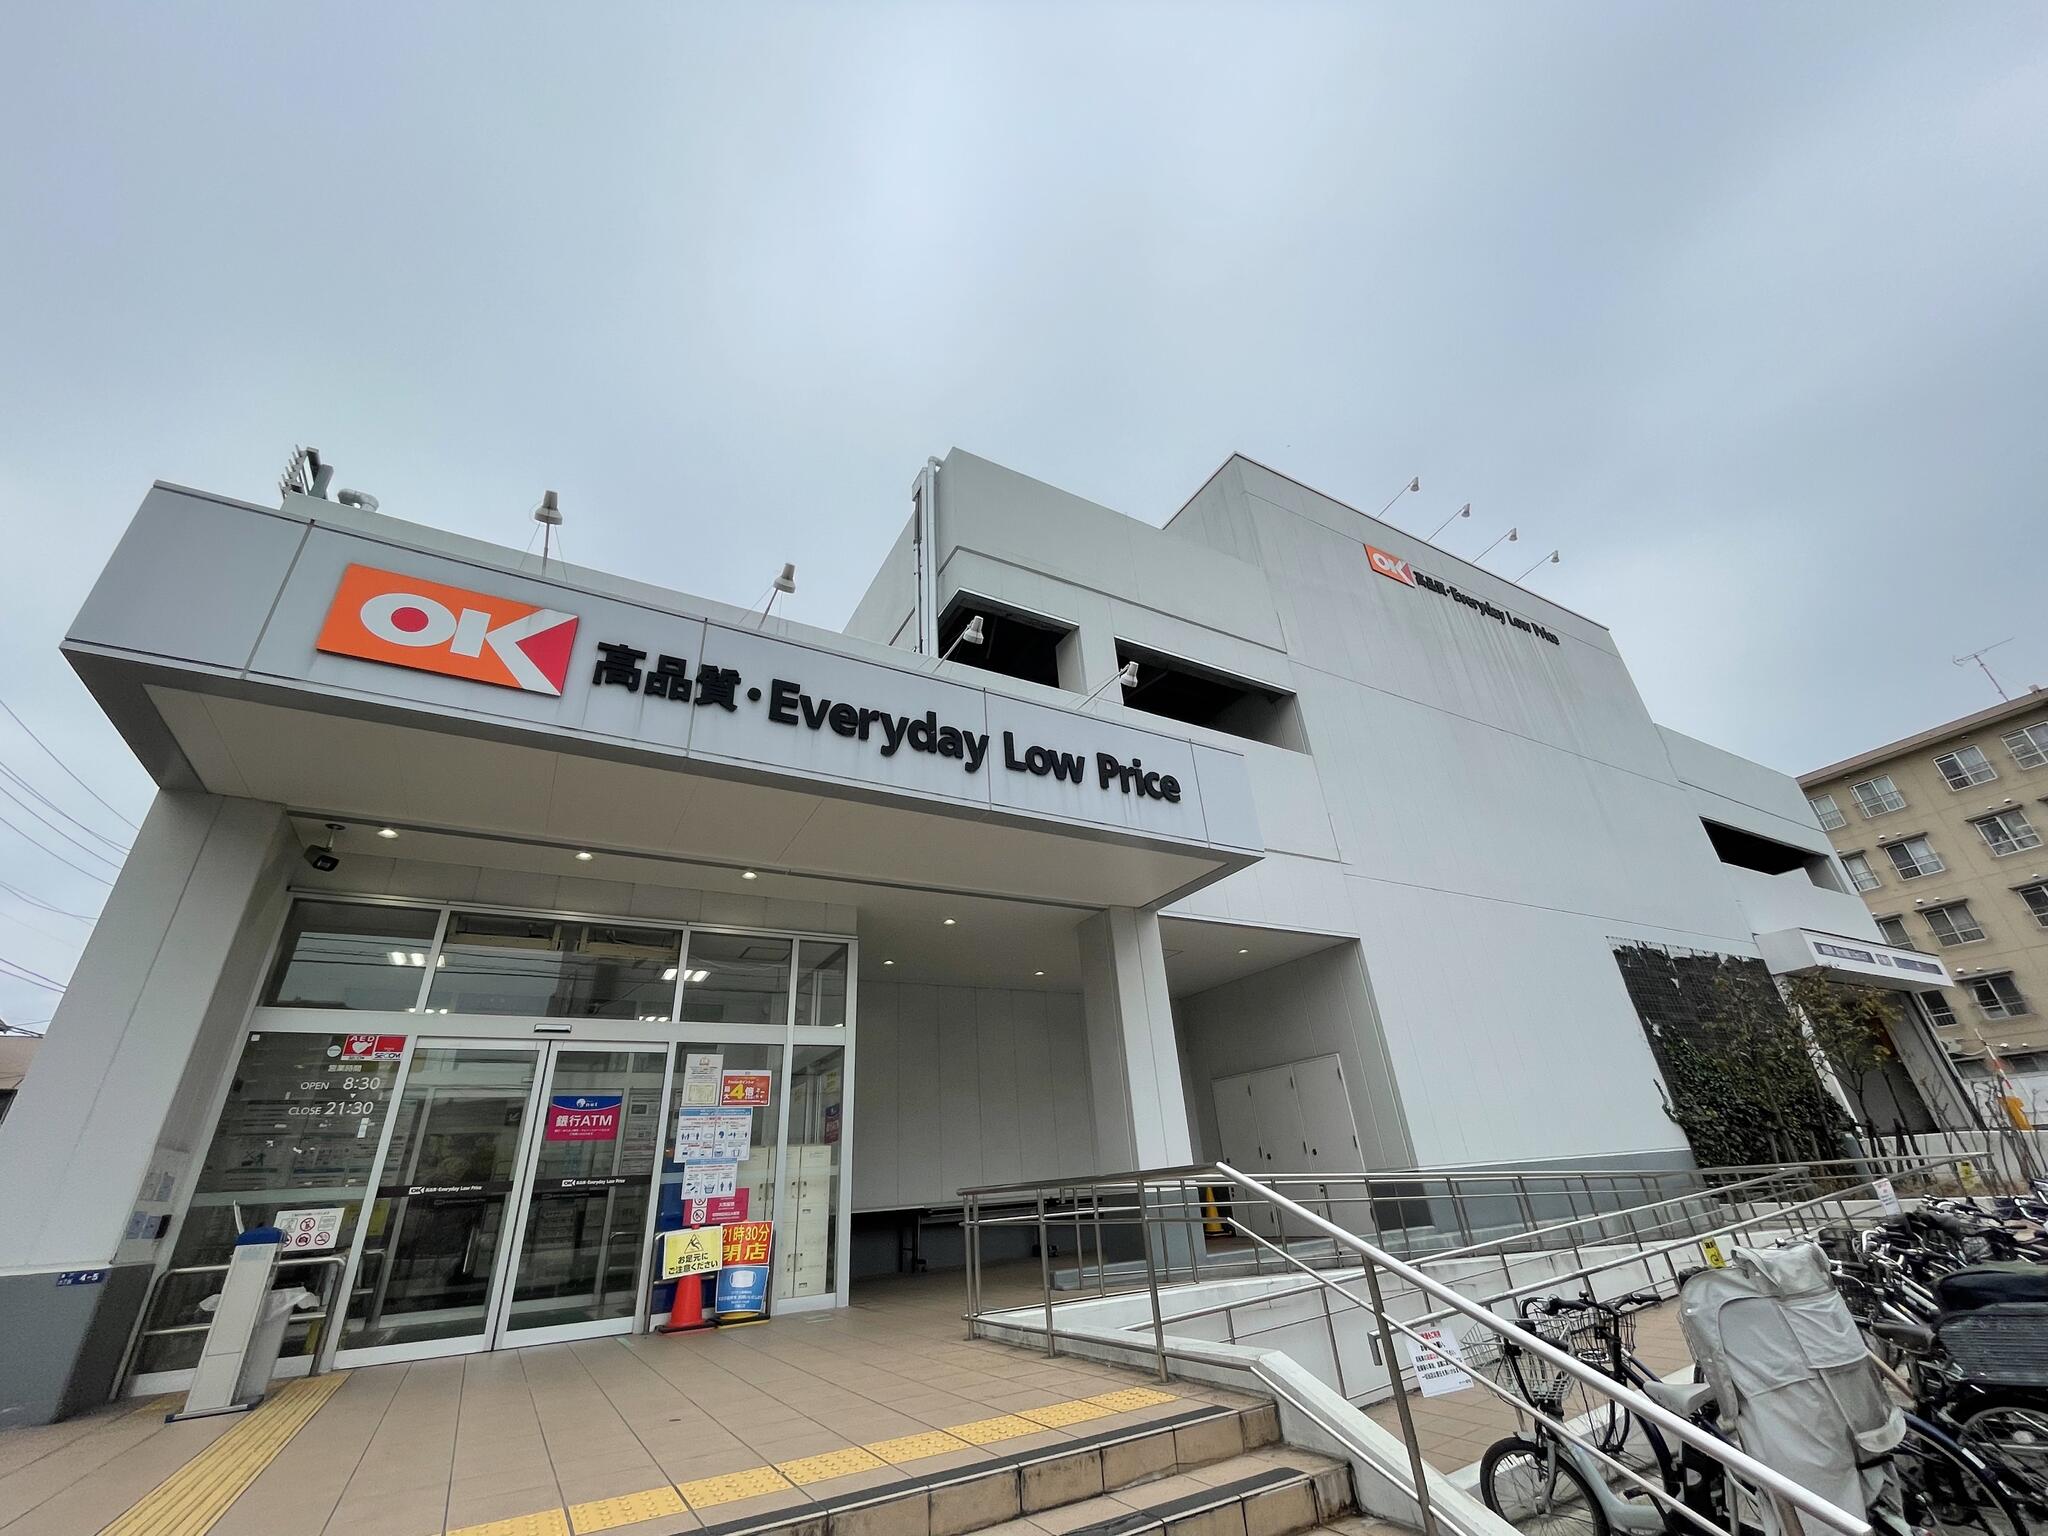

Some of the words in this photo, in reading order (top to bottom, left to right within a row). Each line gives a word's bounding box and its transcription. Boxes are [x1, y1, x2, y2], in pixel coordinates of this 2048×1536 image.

[1373, 553, 1415, 587] OK
[360, 593, 578, 697] OK
[767, 678, 990, 773] Everyday
[1003, 731, 1086, 784] Low
[1096, 751, 1182, 803] Price
[300, 1081, 330, 1090] OPEN
[342, 1077, 381, 1090] 8:30
[287, 1106, 322, 1115] CLOSE
[324, 1101, 374, 1115] 21:30
[677, 1252, 709, 1265] お足元に
[723, 1242, 768, 1262] 閉店
[667, 1260, 718, 1275] ご注意ください
